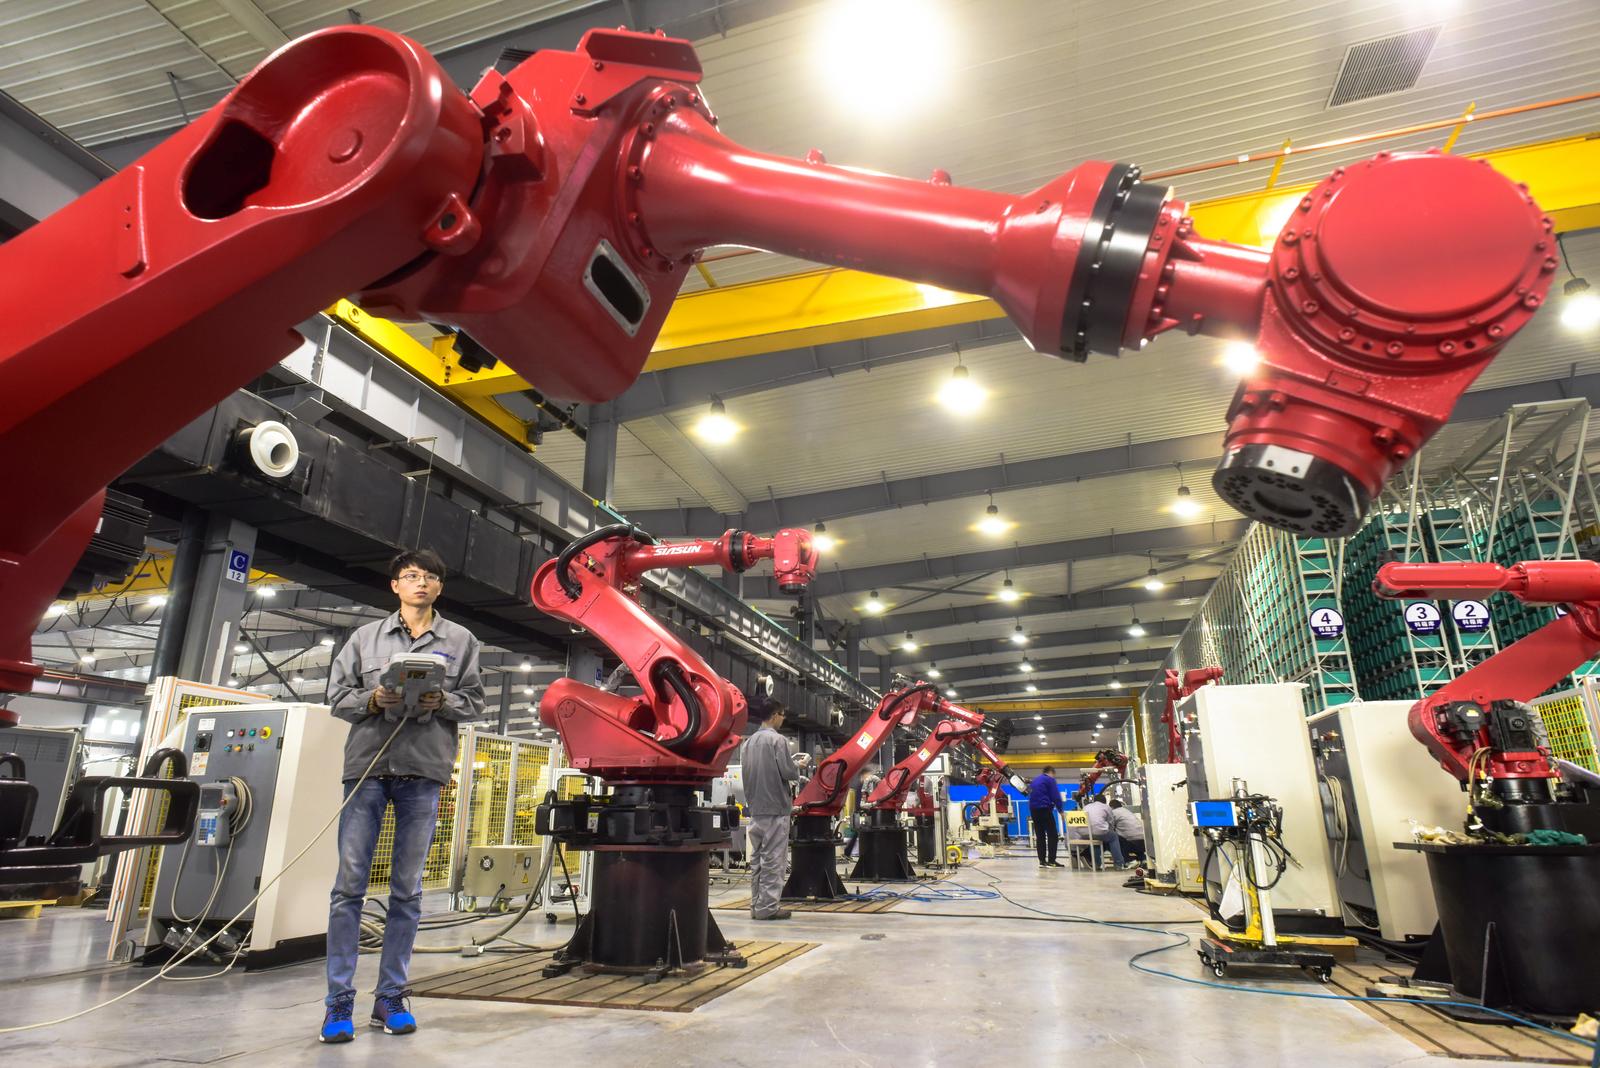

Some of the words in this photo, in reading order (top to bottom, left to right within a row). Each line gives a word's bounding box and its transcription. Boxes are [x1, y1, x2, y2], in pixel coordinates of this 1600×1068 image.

[653, 545, 702, 556] SIASUN
[233, 555, 246, 569] C
[231, 571, 242, 581] 12
[1416, 606, 1428, 620] 3
[1464, 604, 1477, 617] 2
[1321, 612, 1331, 624] 4
